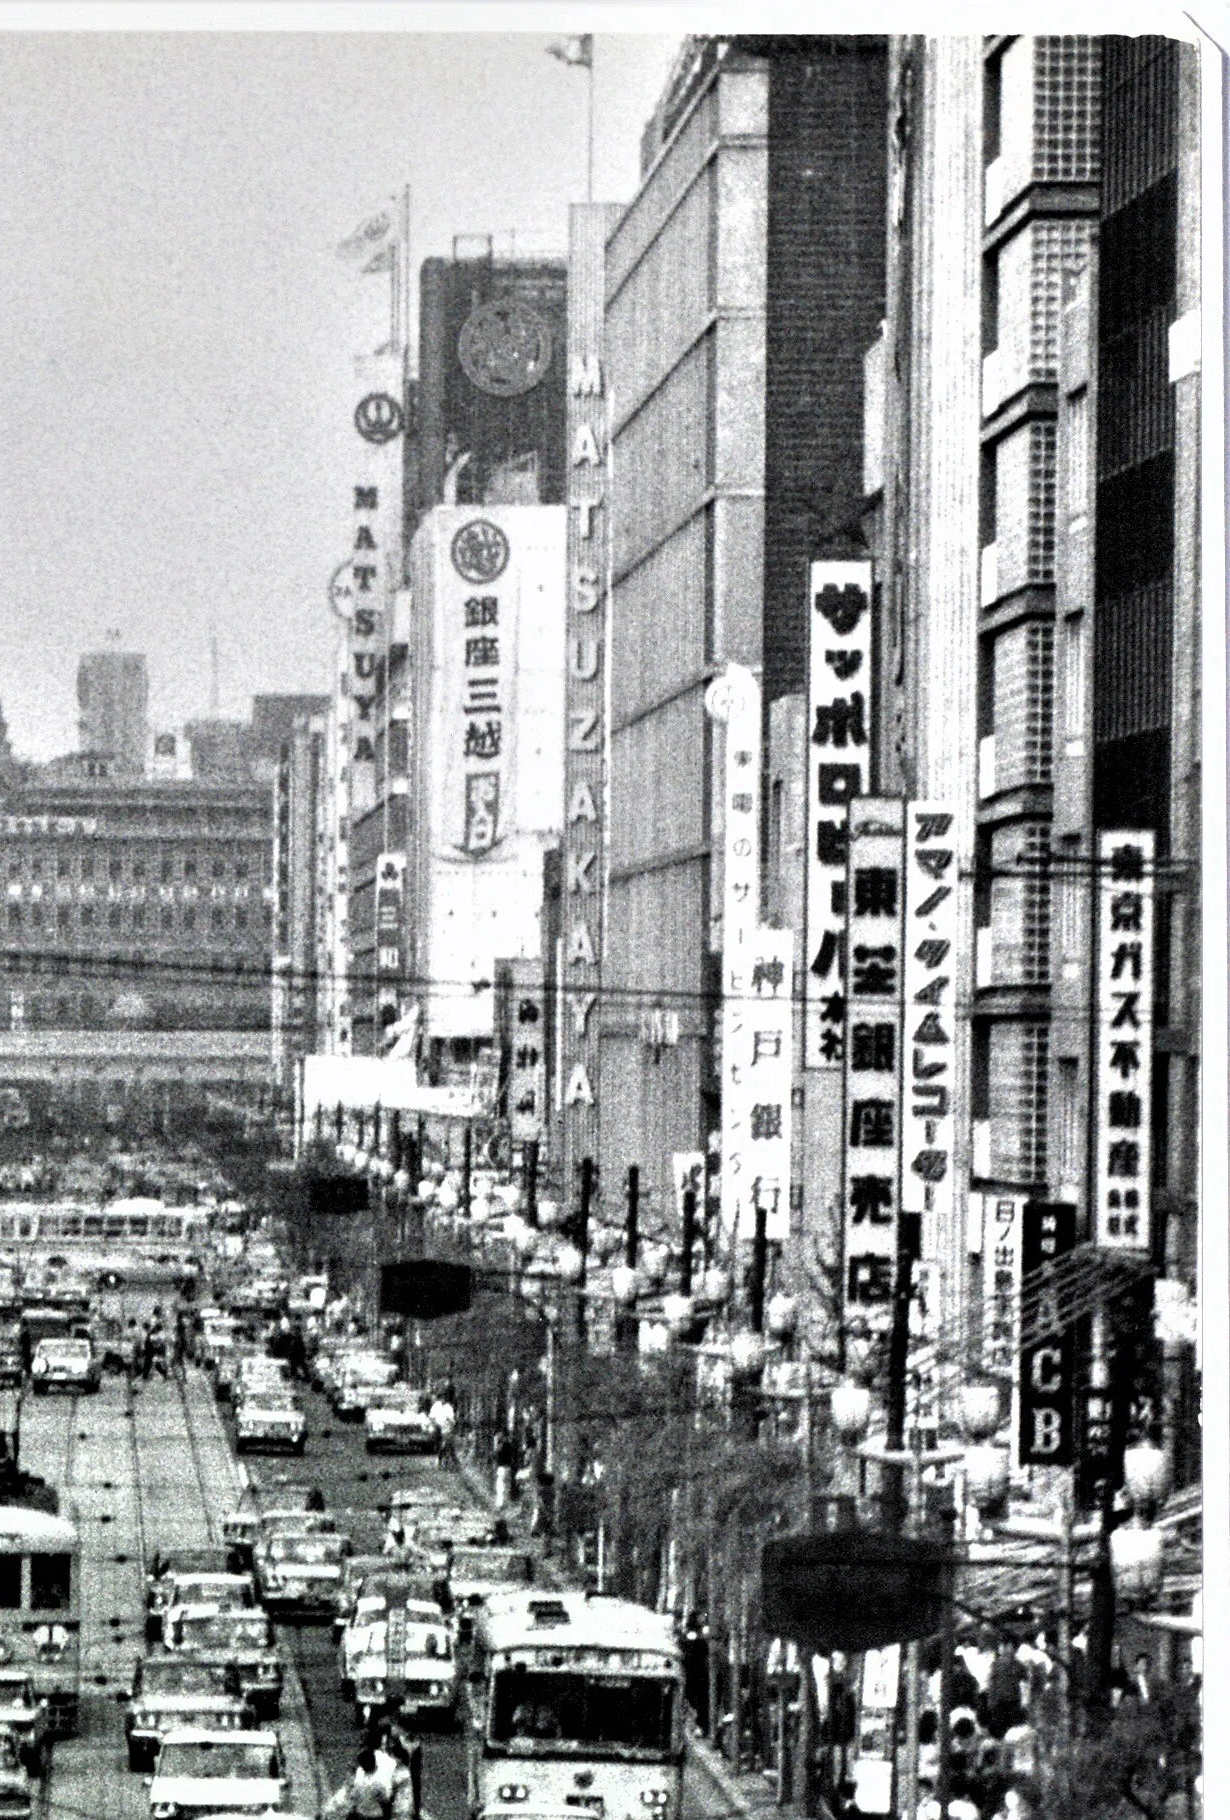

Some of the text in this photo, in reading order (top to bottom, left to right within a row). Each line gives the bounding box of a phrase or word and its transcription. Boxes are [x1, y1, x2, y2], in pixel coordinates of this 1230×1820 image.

[354, 486, 379, 762] MATSUYA
[464, 598, 503, 758] 銀座三越
[567, 350, 603, 1108] MATSUZAKAYA
[751, 956, 785, 1214] 神戸銀行
[849, 867, 898, 1303] 東芝銀座売店
